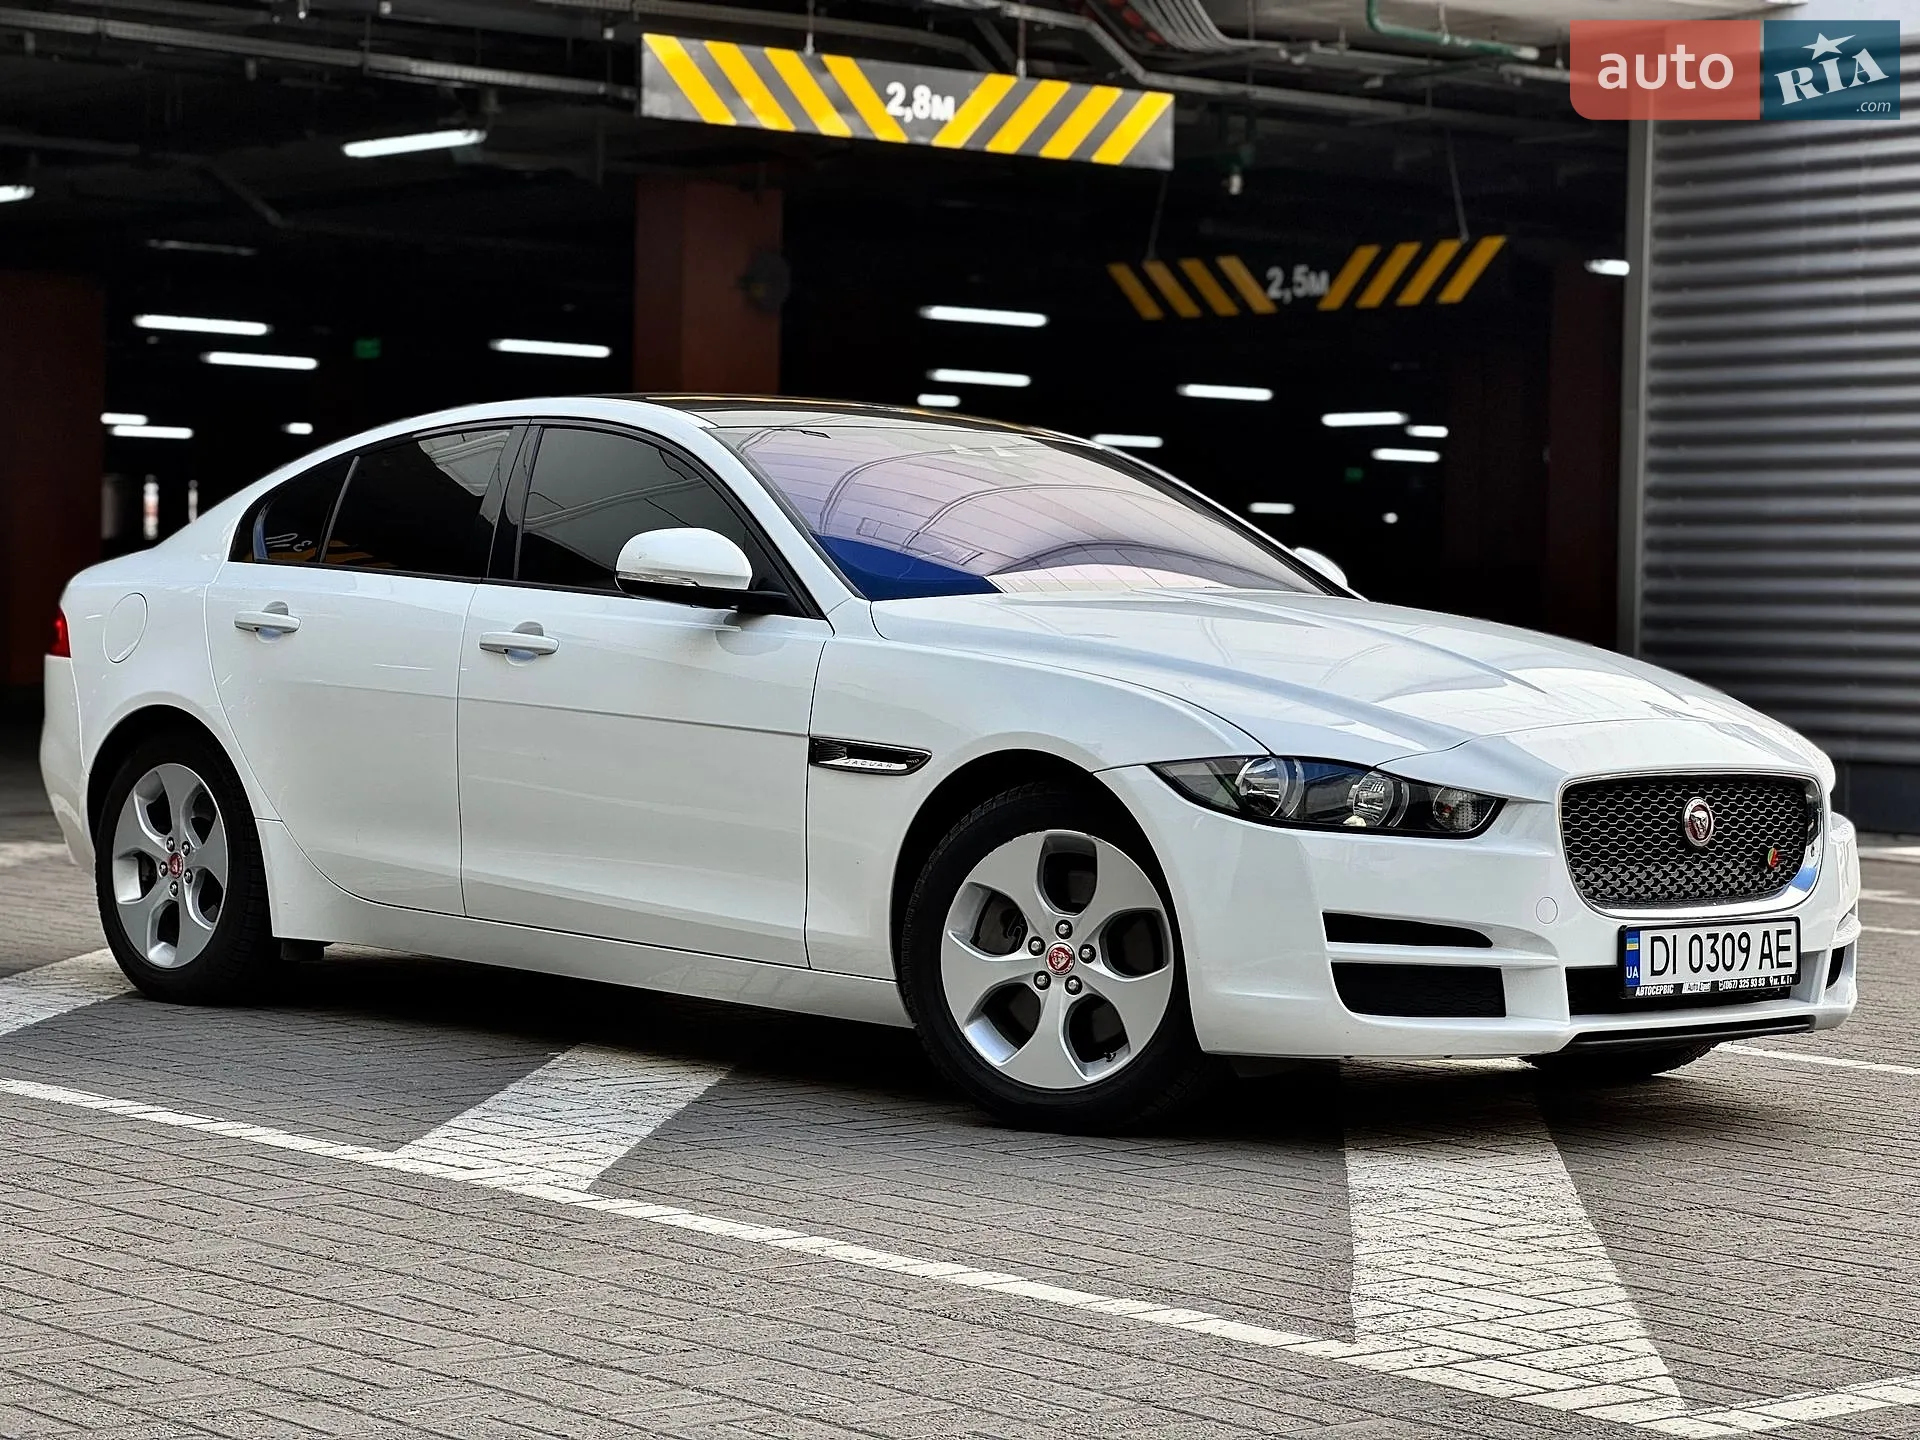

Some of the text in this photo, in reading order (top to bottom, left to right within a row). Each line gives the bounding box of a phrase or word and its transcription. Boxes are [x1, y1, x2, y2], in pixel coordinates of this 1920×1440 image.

[844, 759, 893, 769] JAGUAR
[1650, 929, 1792, 977] DI 0309 AE
[1626, 966, 1639, 979] UA
[1635, 984, 1674, 997] АВТОСЕРВІС
[1738, 978, 1749, 988] 325
